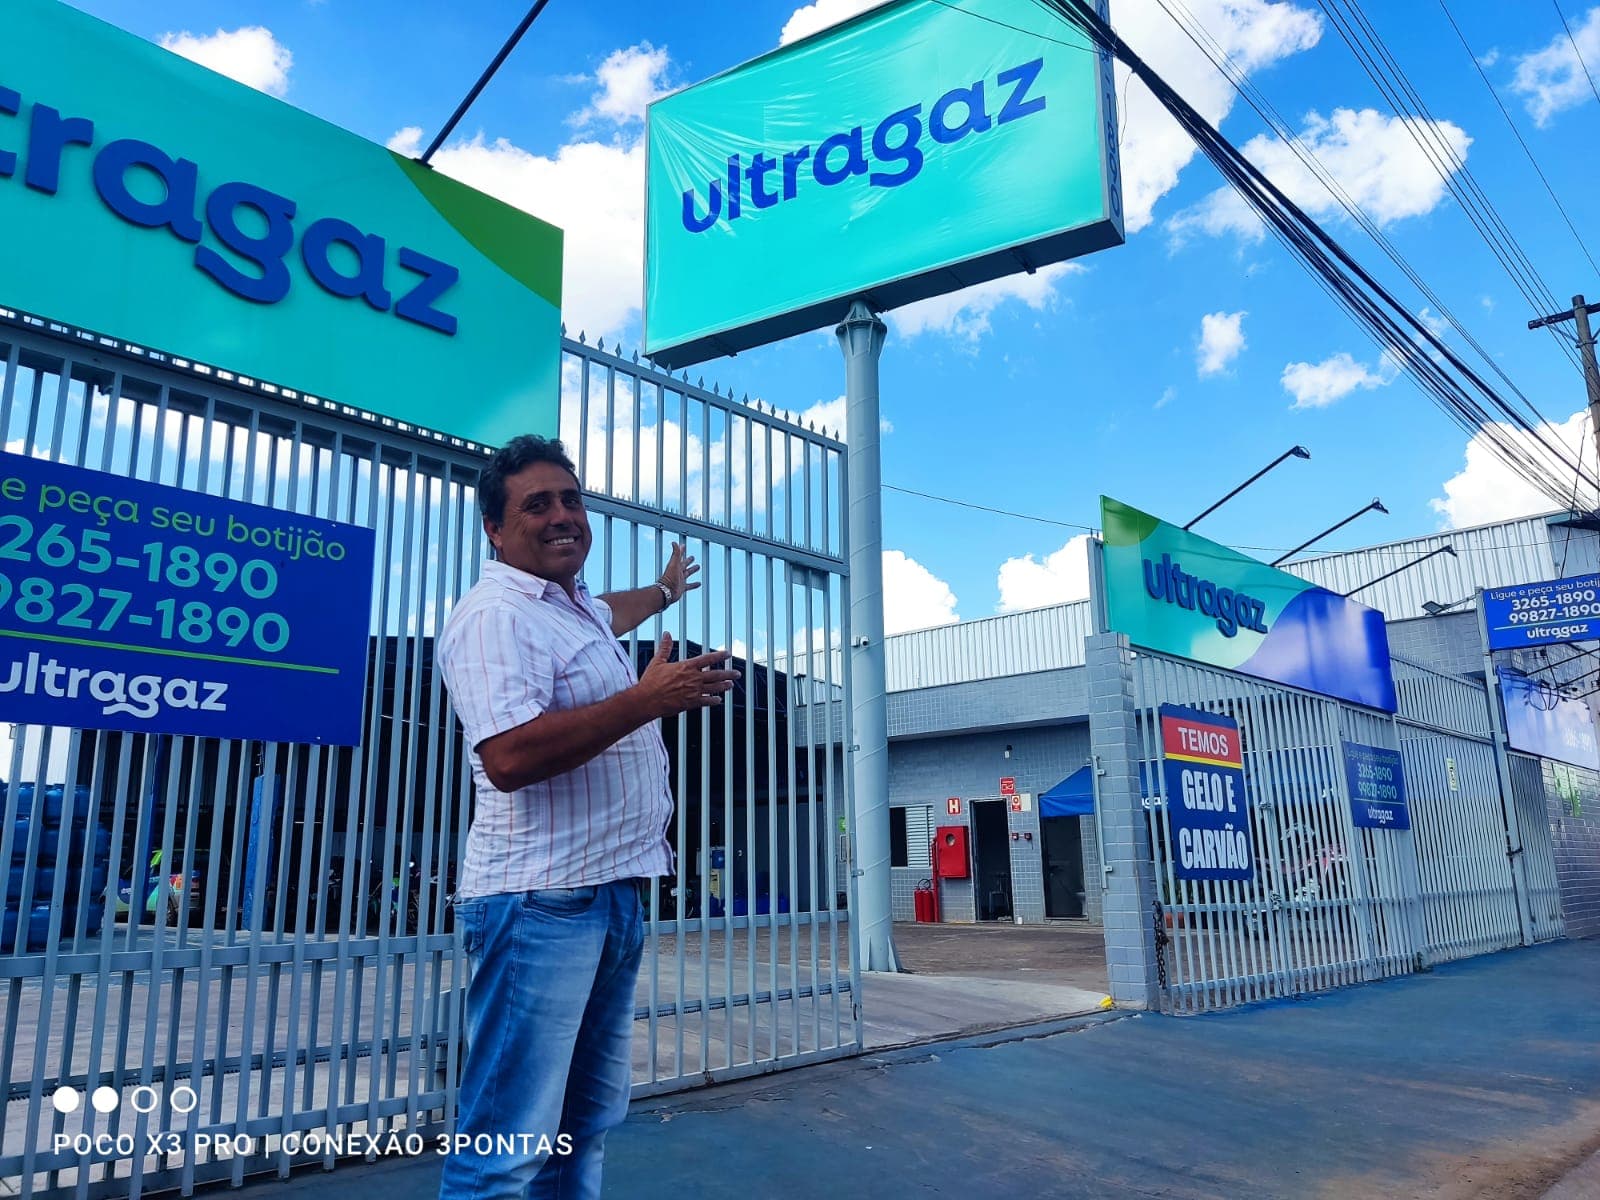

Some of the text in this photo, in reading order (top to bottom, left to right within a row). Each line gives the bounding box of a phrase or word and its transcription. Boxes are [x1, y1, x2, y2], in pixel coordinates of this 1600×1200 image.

[682, 57, 1046, 234] ultragaz
[1, 477, 346, 561] e peça seu botijão
[1143, 553, 1268, 638] ultragaz
[1490, 591, 1517, 601] Ligue
[1528, 586, 1553, 597] peça
[1556, 583, 1574, 591] seu
[1511, 590, 1596, 611] 3265-1890
[1509, 603, 1600, 624] 99827-1890
[1526, 624, 1589, 639] ultragaz
[1178, 727, 1229, 757] TEMOS
[1181, 768, 1236, 813] GELO E
[1367, 805, 1394, 825] ultragaz
[1178, 822, 1249, 871] CARVÃO
